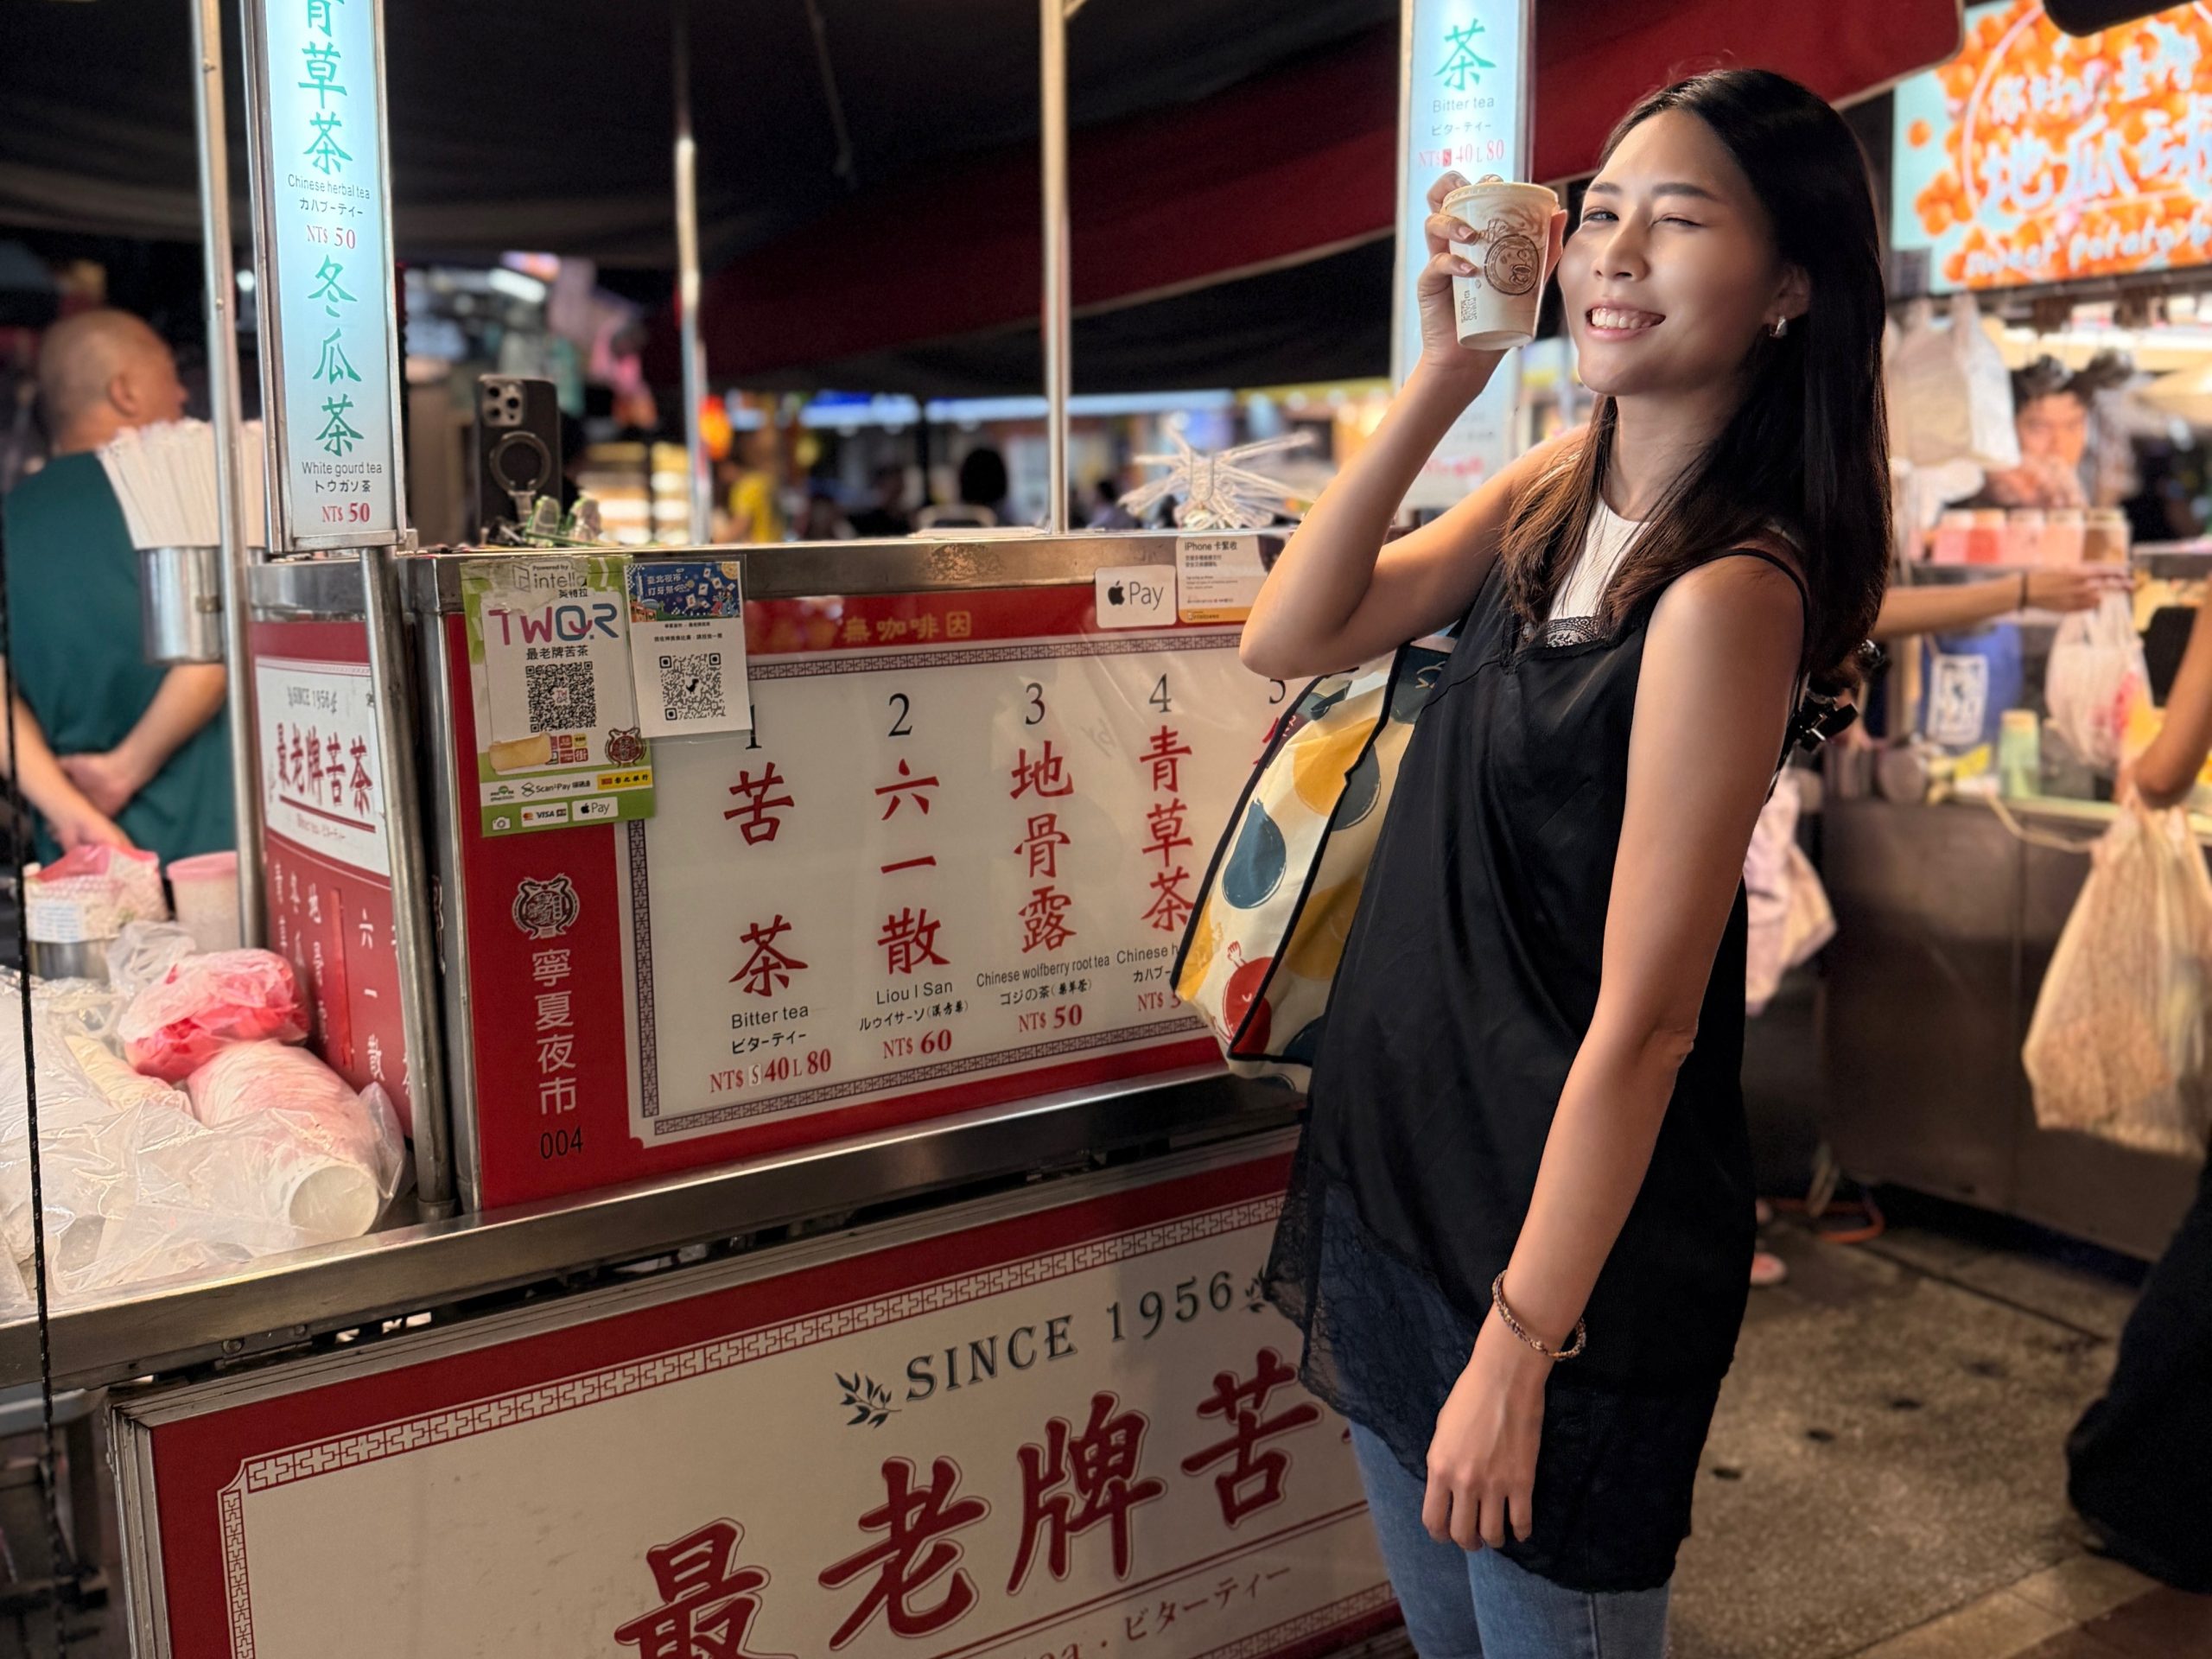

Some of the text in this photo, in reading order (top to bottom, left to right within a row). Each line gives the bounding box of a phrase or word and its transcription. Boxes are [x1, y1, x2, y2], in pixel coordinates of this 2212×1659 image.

[1433, 18, 1497, 91] 茶
[1433, 97, 1494, 113] Bitter tea
[1456, 143, 1473, 163] 40
[1486, 139, 1505, 161] 80
[288, 174, 370, 200] Chinese herbal tea
[334, 227, 356, 250] 50
[307, 255, 364, 457] 冬瓜茶
[302, 461, 382, 477] White gourd tea
[321, 502, 371, 523] NT$ 50
[1185, 541, 1212, 551] iPhone
[1129, 581, 1164, 611] Pay
[488, 602, 620, 646] TWQR
[842, 611, 972, 643] 無咖啡因
[526, 645, 588, 660] 最老牌苦茶
[1025, 681, 1046, 726] 3
[1148, 672, 1173, 715] 4
[744, 704, 762, 751] 1
[887, 692, 914, 738] 2
[536, 810, 555, 819] VISA
[591, 802, 610, 816] Pay
[1138, 725, 1194, 933] 青草茶
[1009, 740, 1077, 955] 地骨露
[724, 761, 809, 999] 苦茶
[874, 758, 952, 976] 六一散
[1116, 945, 1168, 964] Chinese
[976, 954, 1110, 989] Chinese wolfberry root tea
[876, 988, 910, 1005] Liou
[922, 980, 954, 997] San
[1136, 992, 1165, 1013] NT$
[531, 947, 577, 1116] 寧夏夜市
[731, 1004, 810, 1030] Bitter tea
[1018, 1002, 1083, 1034] NT$ 50
[731, 1031, 807, 1055] ビターティー
[882, 1028, 953, 1059] NT$ 60
[709, 1068, 745, 1094] NT$
[764, 1056, 790, 1083] 40
[792, 1058, 803, 1077] L
[806, 1047, 832, 1074] 80
[540, 1126, 583, 1160] 004
[906, 1268, 1236, 1403] SINCE 1956
[613, 1344, 1348, 1659] 最老牌苦
[1124, 1565, 1292, 1643] ビターティー
